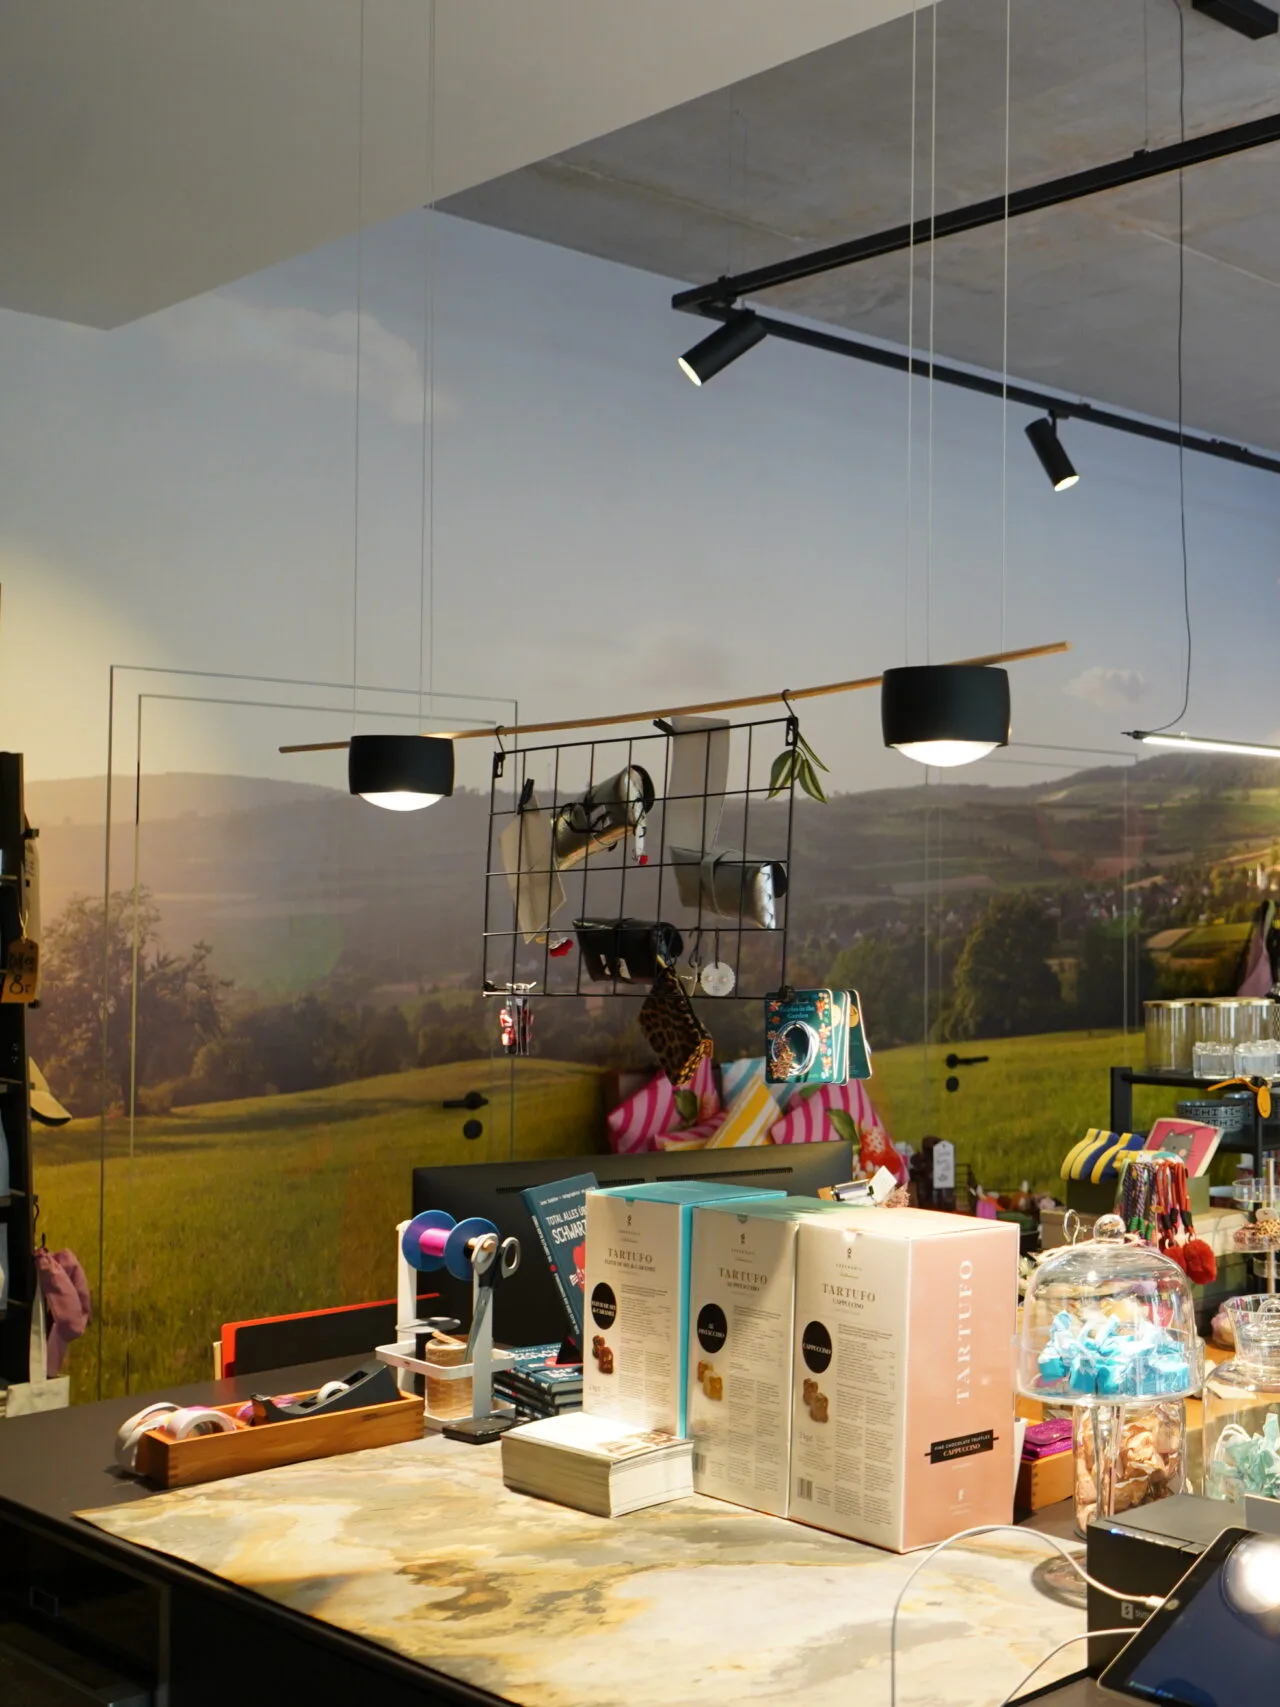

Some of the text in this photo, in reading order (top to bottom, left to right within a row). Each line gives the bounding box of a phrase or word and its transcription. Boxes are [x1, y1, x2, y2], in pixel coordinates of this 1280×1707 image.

[546, 1214, 564, 1226] TOTAL
[563, 1208, 579, 1221] ALLES
[607, 1247, 653, 1265] TARTUFO
[719, 1266, 769, 1286] TARTUFO
[822, 1282, 877, 1303] TARTUFO
[956, 1259, 974, 1405] TARTUFO
